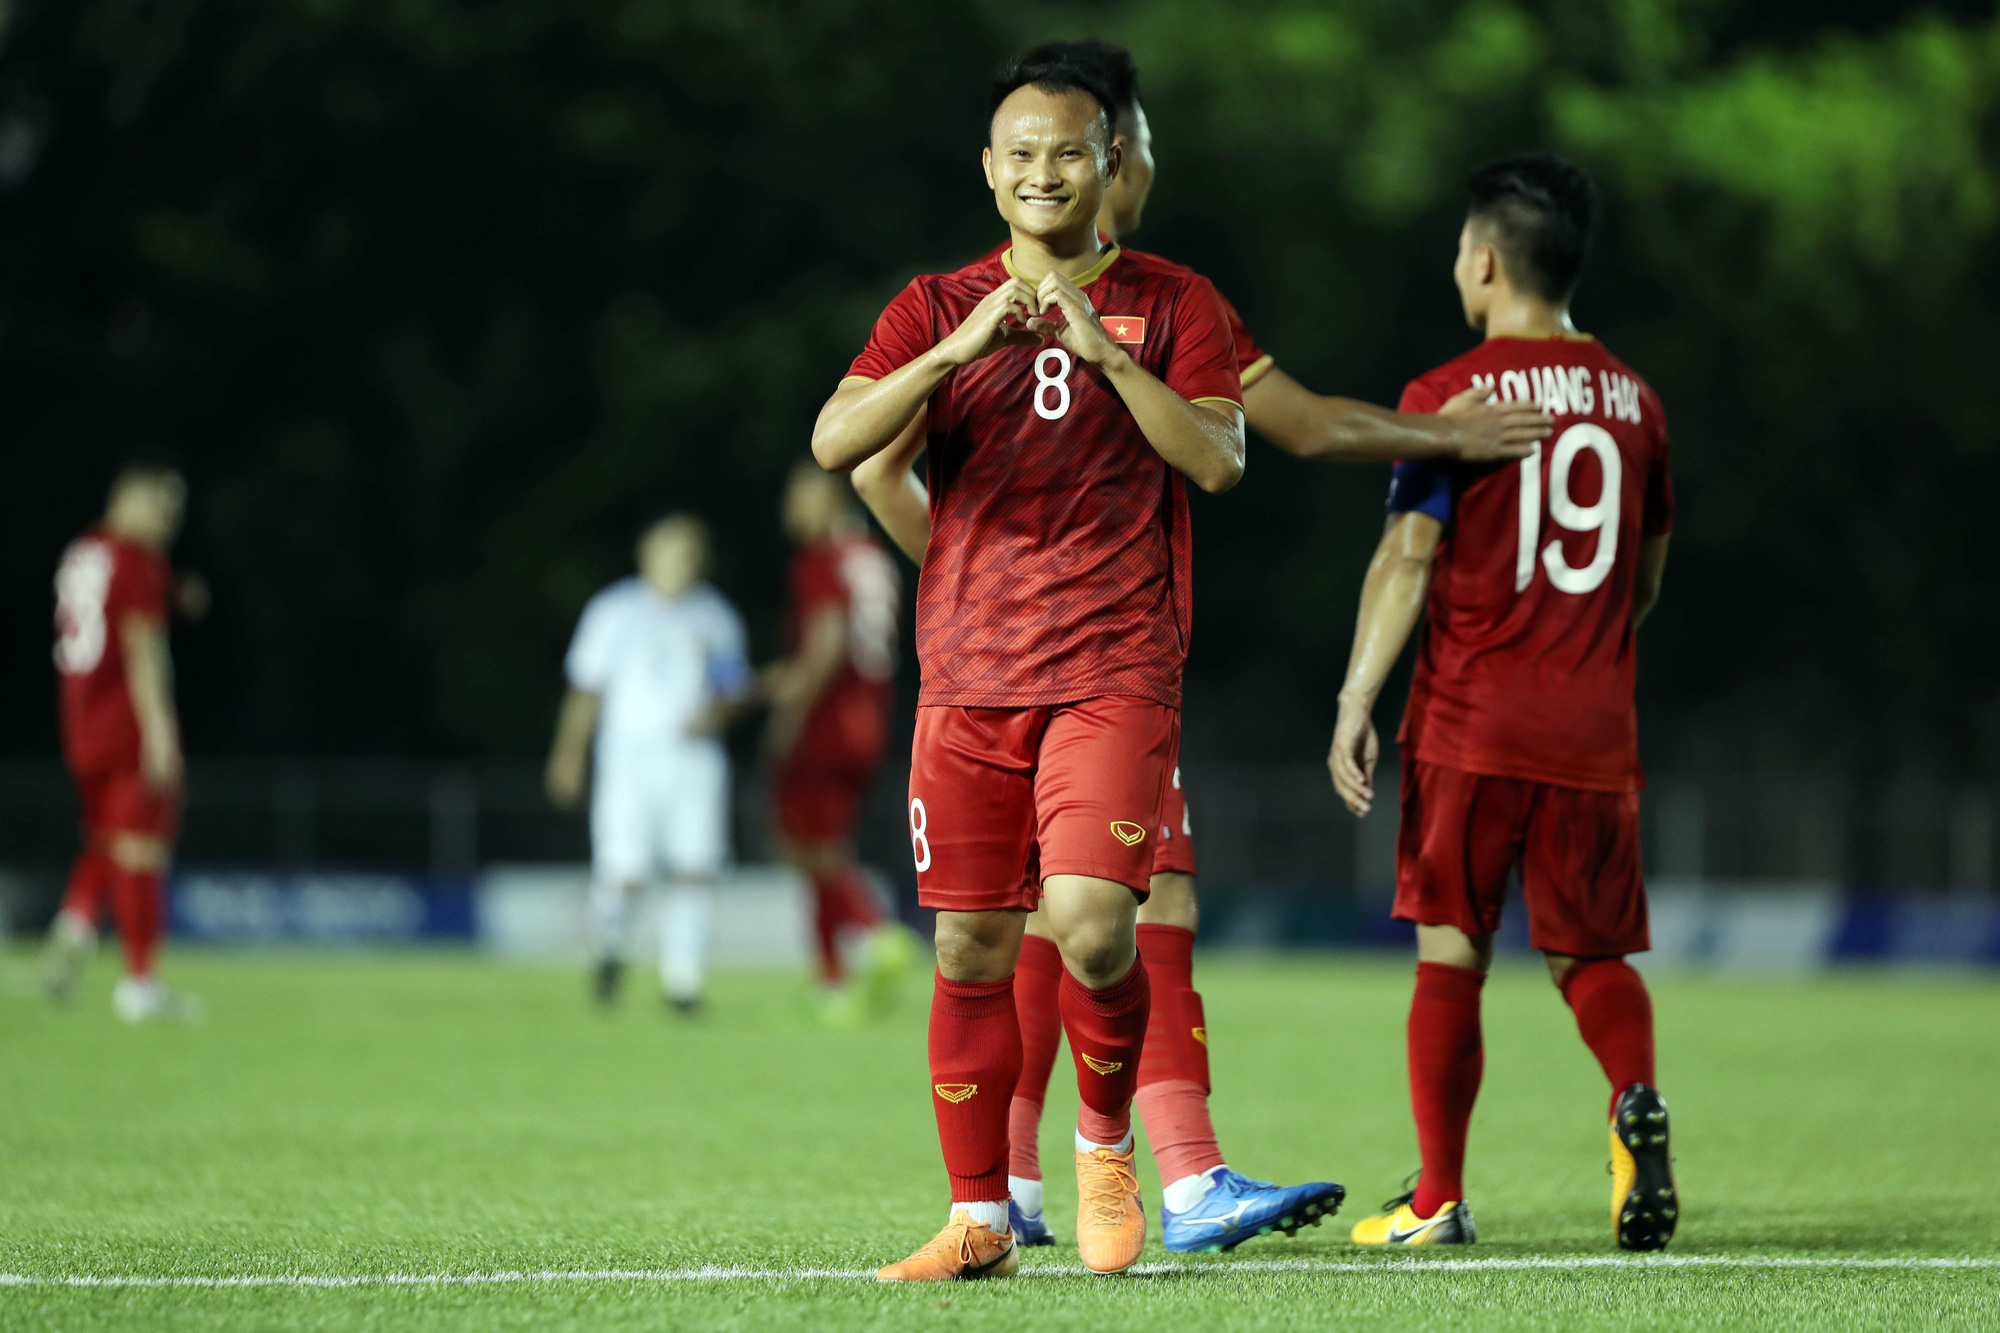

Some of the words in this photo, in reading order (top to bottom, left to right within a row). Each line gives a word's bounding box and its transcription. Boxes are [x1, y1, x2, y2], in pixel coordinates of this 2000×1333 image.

[1034, 348, 1070, 420] 8
[1599, 370, 1641, 425] HAI
[1515, 422, 1622, 594] 19
[910, 797, 931, 872] 8
